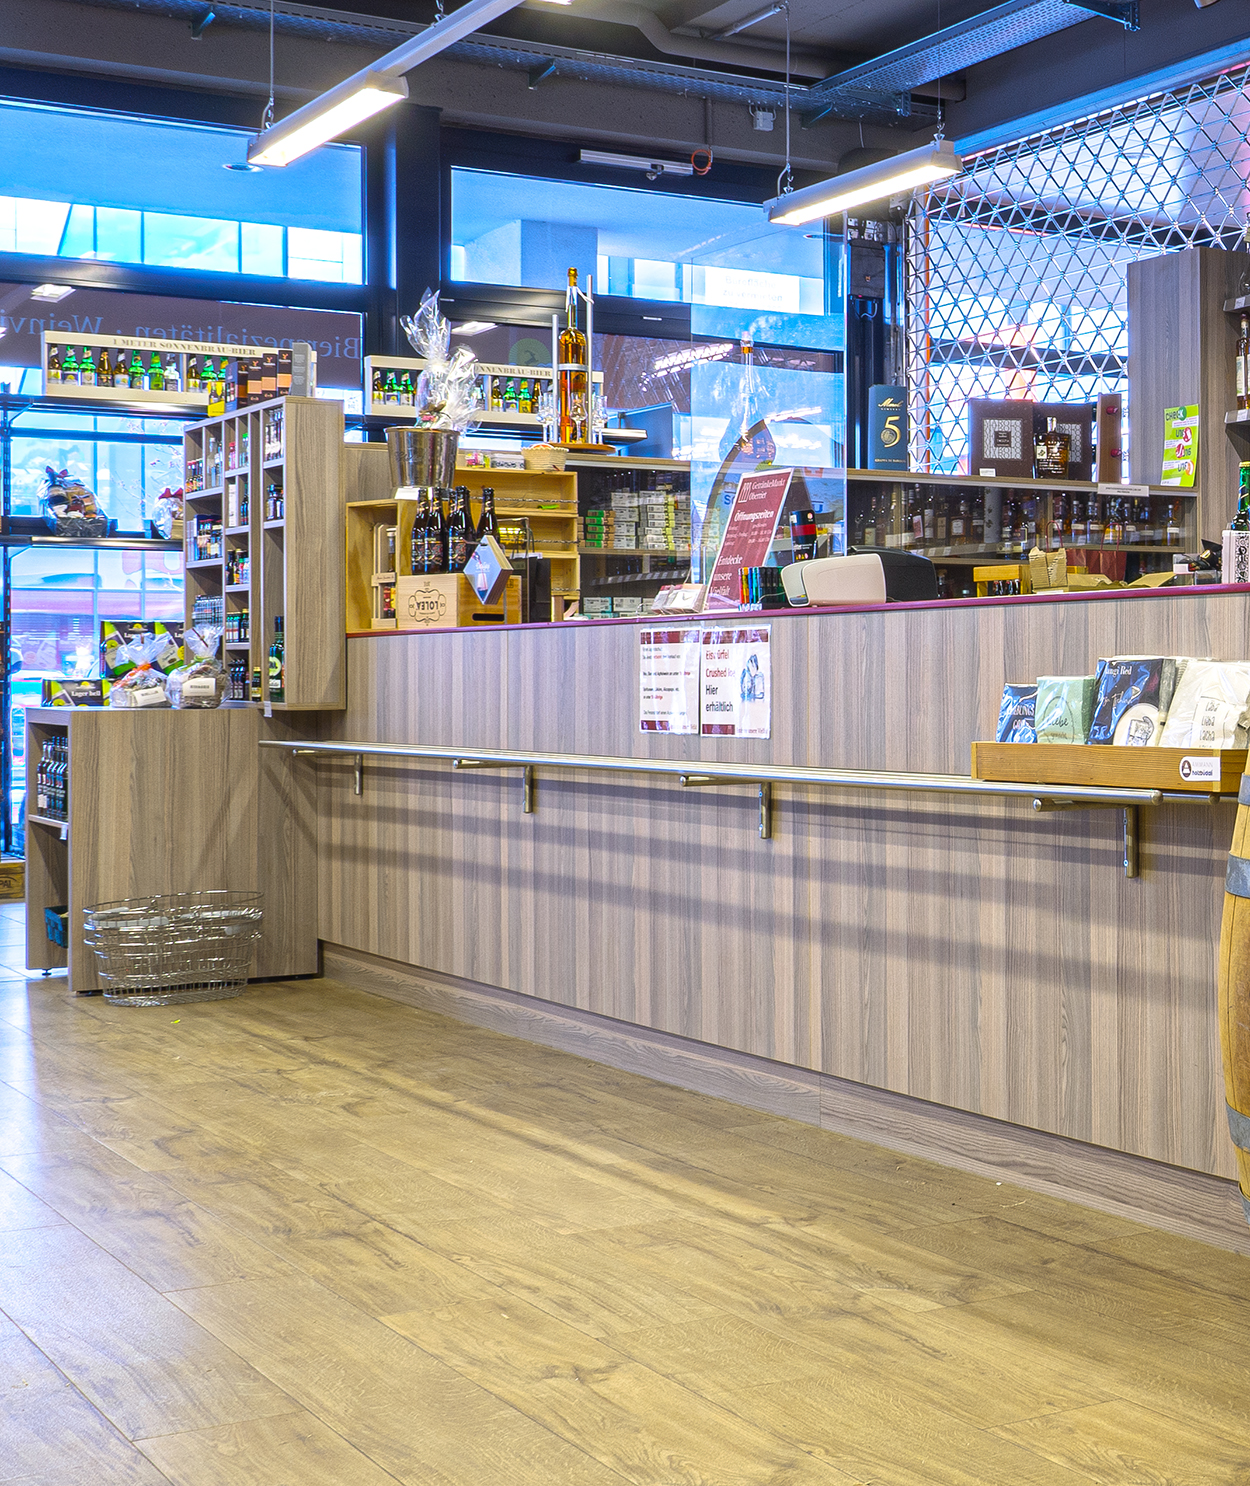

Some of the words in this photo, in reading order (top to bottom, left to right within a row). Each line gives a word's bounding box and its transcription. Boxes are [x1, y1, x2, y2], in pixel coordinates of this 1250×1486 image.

[121, 339, 157, 348] METER
[160, 341, 256, 355] SONNENBRÄU-BIER
[1165, 409, 1184, 421] CHECK
[880, 415, 901, 448] 5
[734, 509, 774, 523] Öffnungszeiten
[717, 554, 743, 566] Entdecke
[416, 600, 439, 610] LOLEA
[706, 668, 727, 677] Crushed
[1120, 666, 1132, 675] Red
[706, 685, 718, 695] Hier
[706, 701, 733, 713] erhältlich
